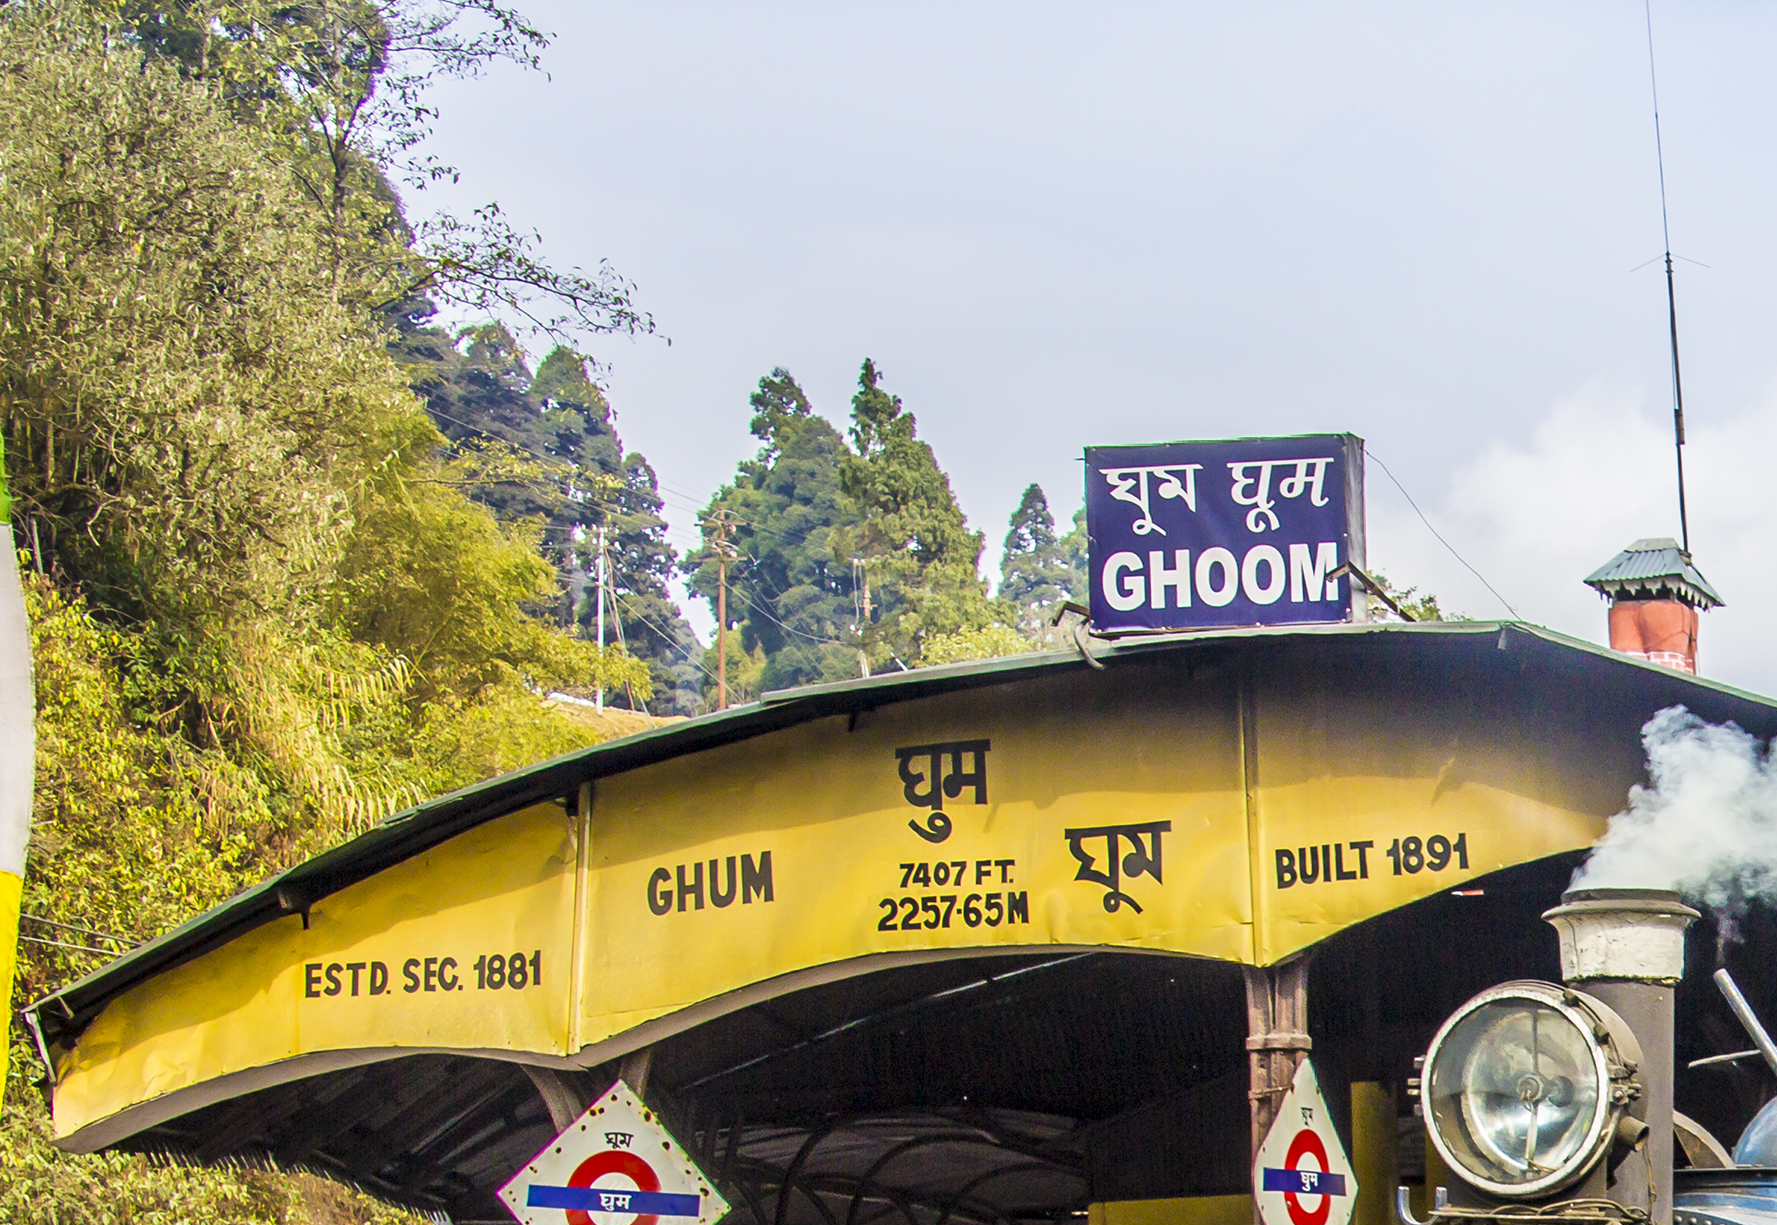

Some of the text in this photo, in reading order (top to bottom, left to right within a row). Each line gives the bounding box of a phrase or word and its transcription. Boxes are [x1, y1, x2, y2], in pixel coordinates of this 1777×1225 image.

[1099, 463, 1204, 536] ঘুম
[1102, 542, 1339, 611] GHOOM
[646, 850, 775, 916] GHUM
[899, 859, 1015, 888] 7407 FT.
[1275, 833, 1470, 889] BUILT 1891
[305, 950, 541, 998] ESTD. SEC. 1881
